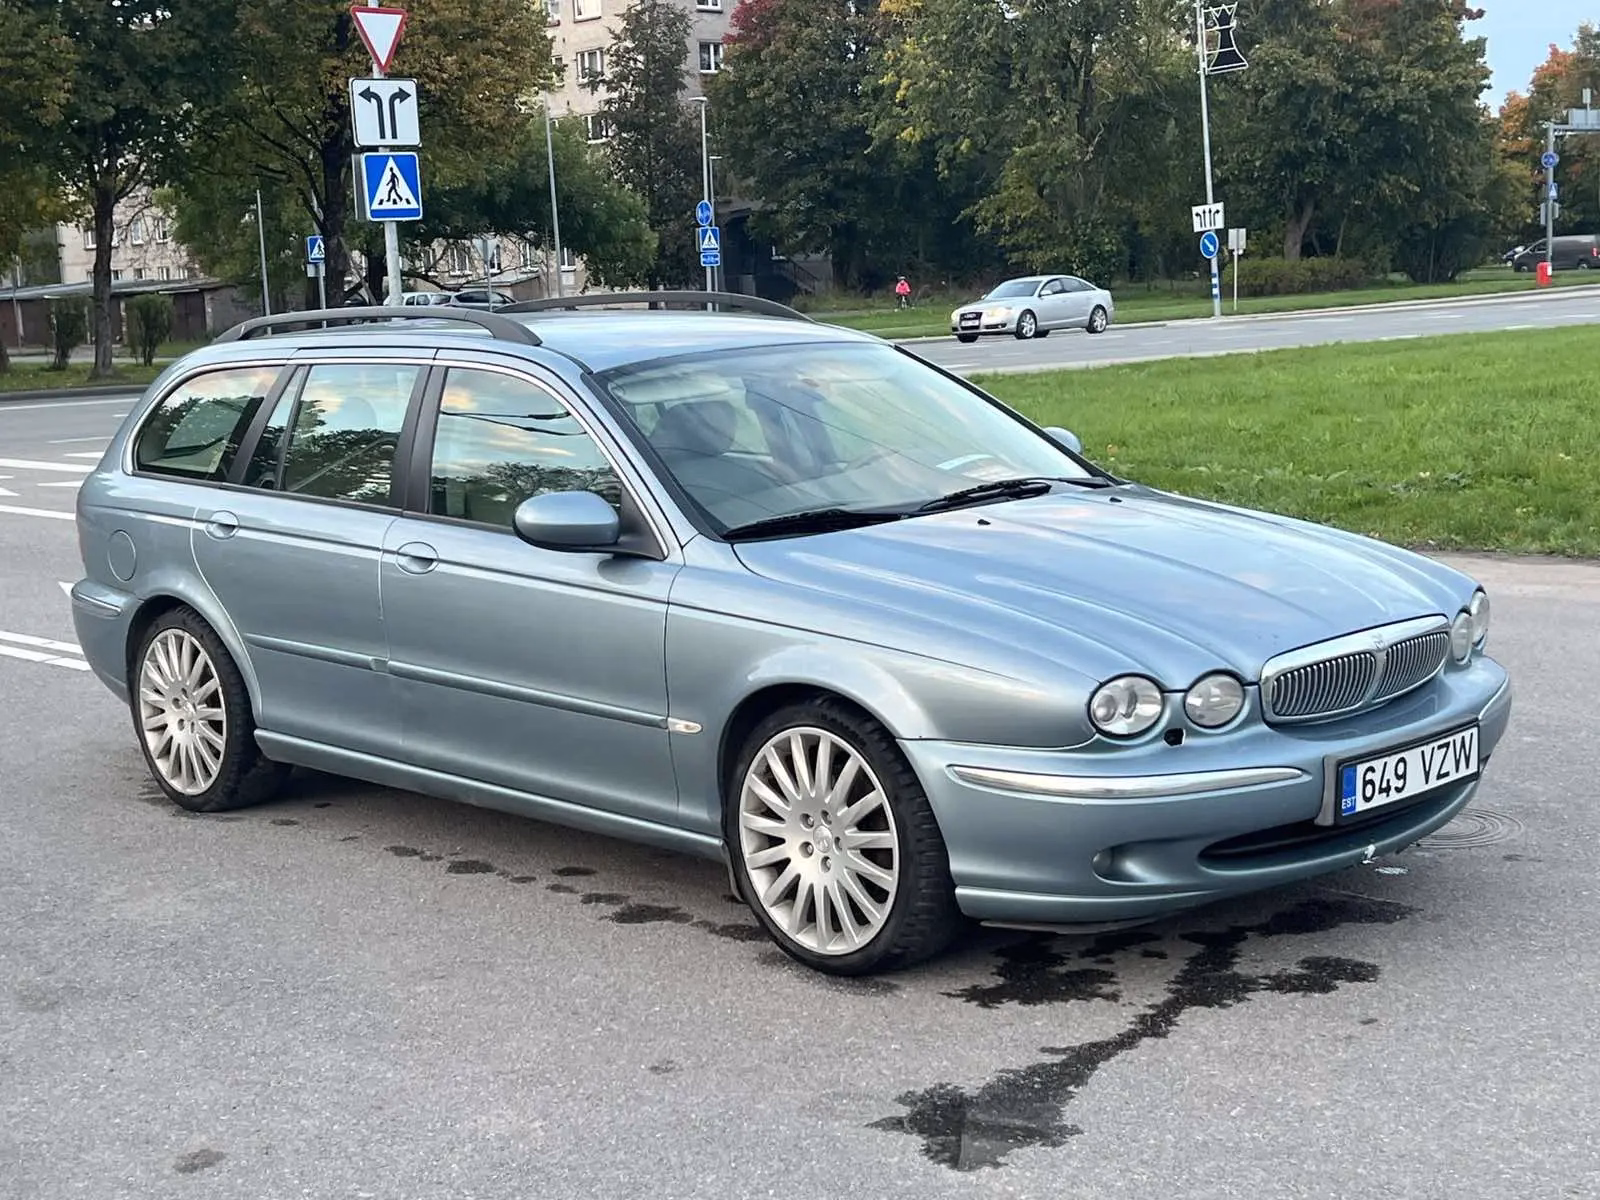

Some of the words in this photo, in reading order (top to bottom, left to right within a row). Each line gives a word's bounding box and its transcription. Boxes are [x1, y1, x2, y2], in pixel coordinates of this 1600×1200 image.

[1362, 756, 1407, 803] 649
[1421, 732, 1473, 785] VZW
[1342, 796, 1356, 809] EST
